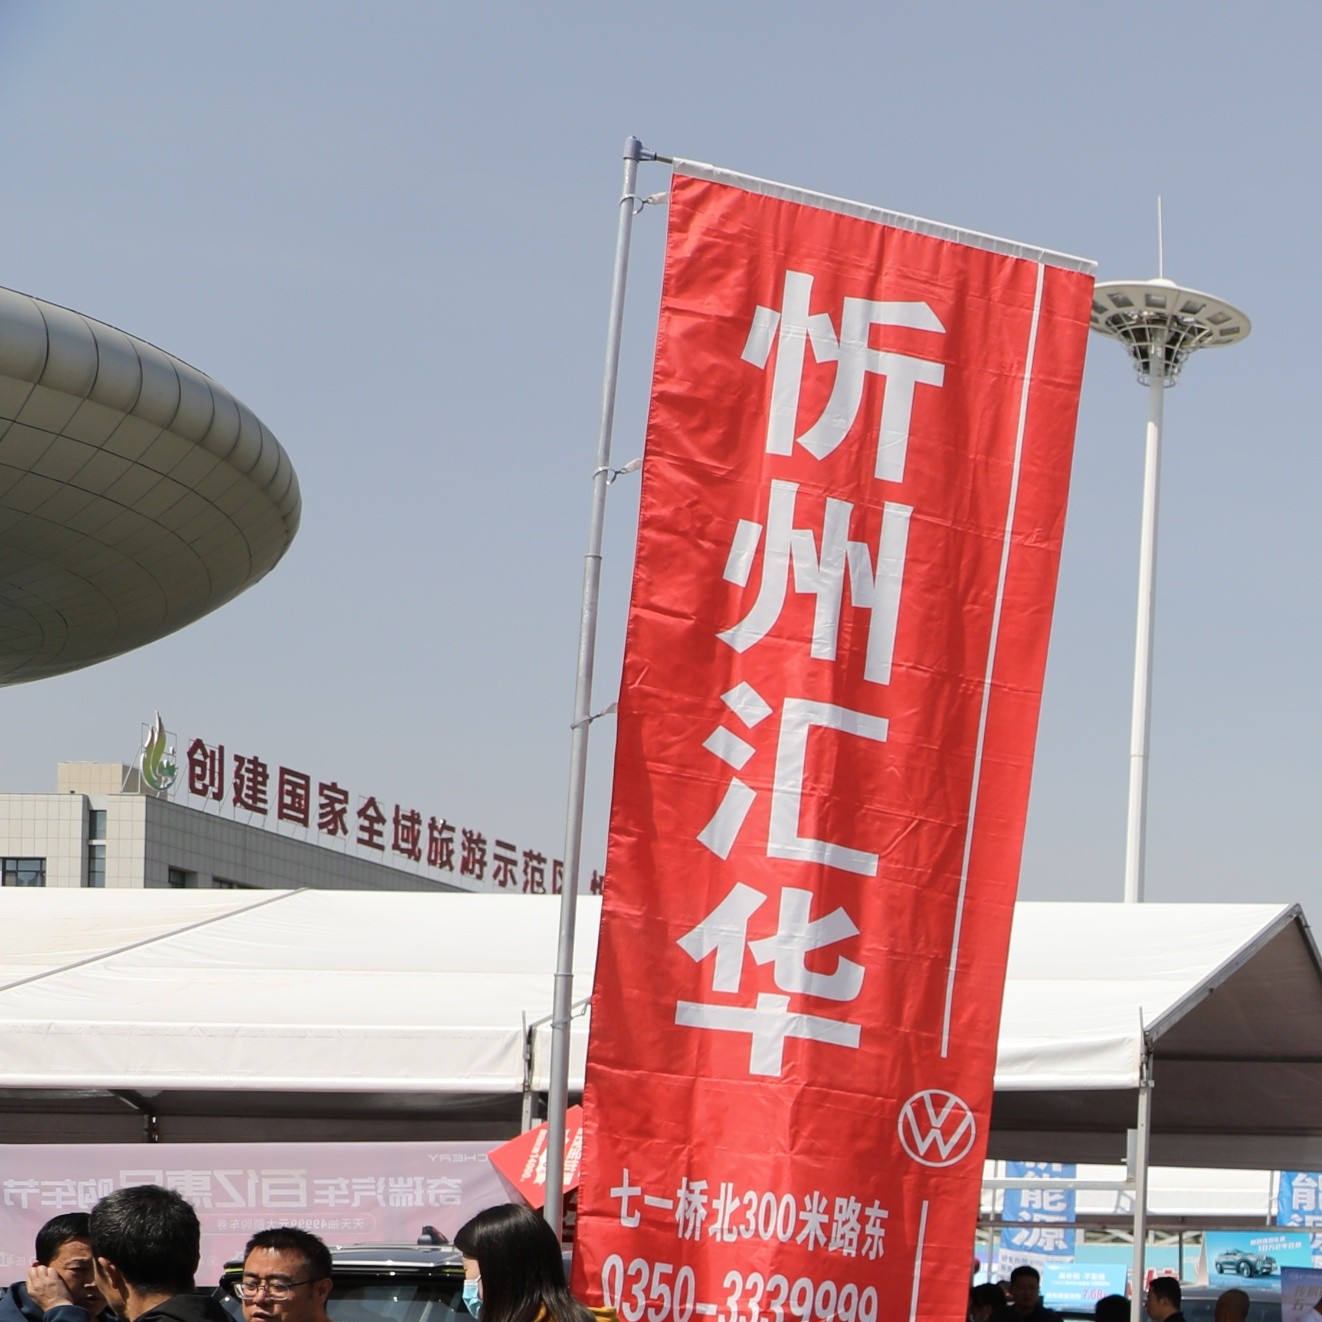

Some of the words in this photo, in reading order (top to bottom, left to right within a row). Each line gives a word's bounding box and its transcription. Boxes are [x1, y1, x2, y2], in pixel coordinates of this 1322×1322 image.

[675, 270, 945, 1077] 忻州汇华
[610, 1167, 889, 1261] 七一桥北300米路东
